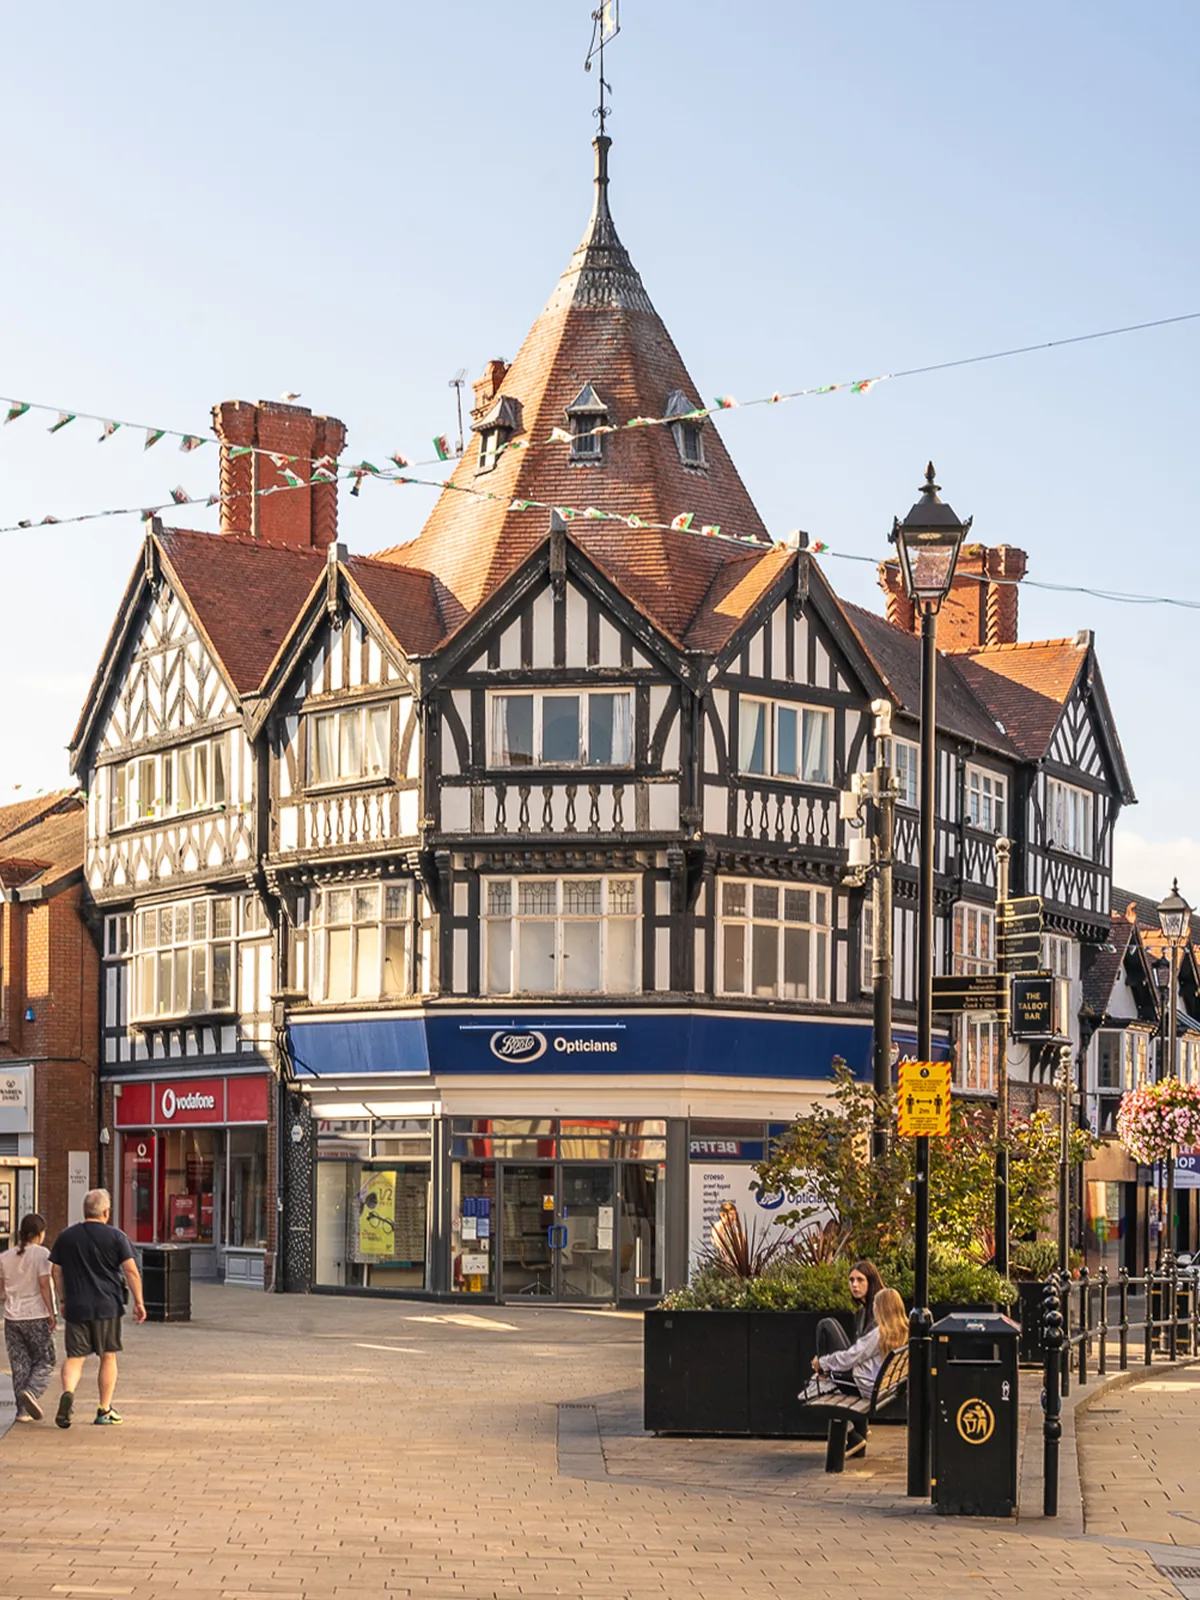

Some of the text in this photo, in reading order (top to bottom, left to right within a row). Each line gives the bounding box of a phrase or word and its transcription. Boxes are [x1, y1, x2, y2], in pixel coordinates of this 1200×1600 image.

[1026, 992, 1041, 1000] THE
[1018, 1002, 1049, 1010] TALBOT
[1024, 1012, 1041, 1020] BAR
[554, 1037, 618, 1054] Opticians
[176, 1092, 215, 1110] vodafone
